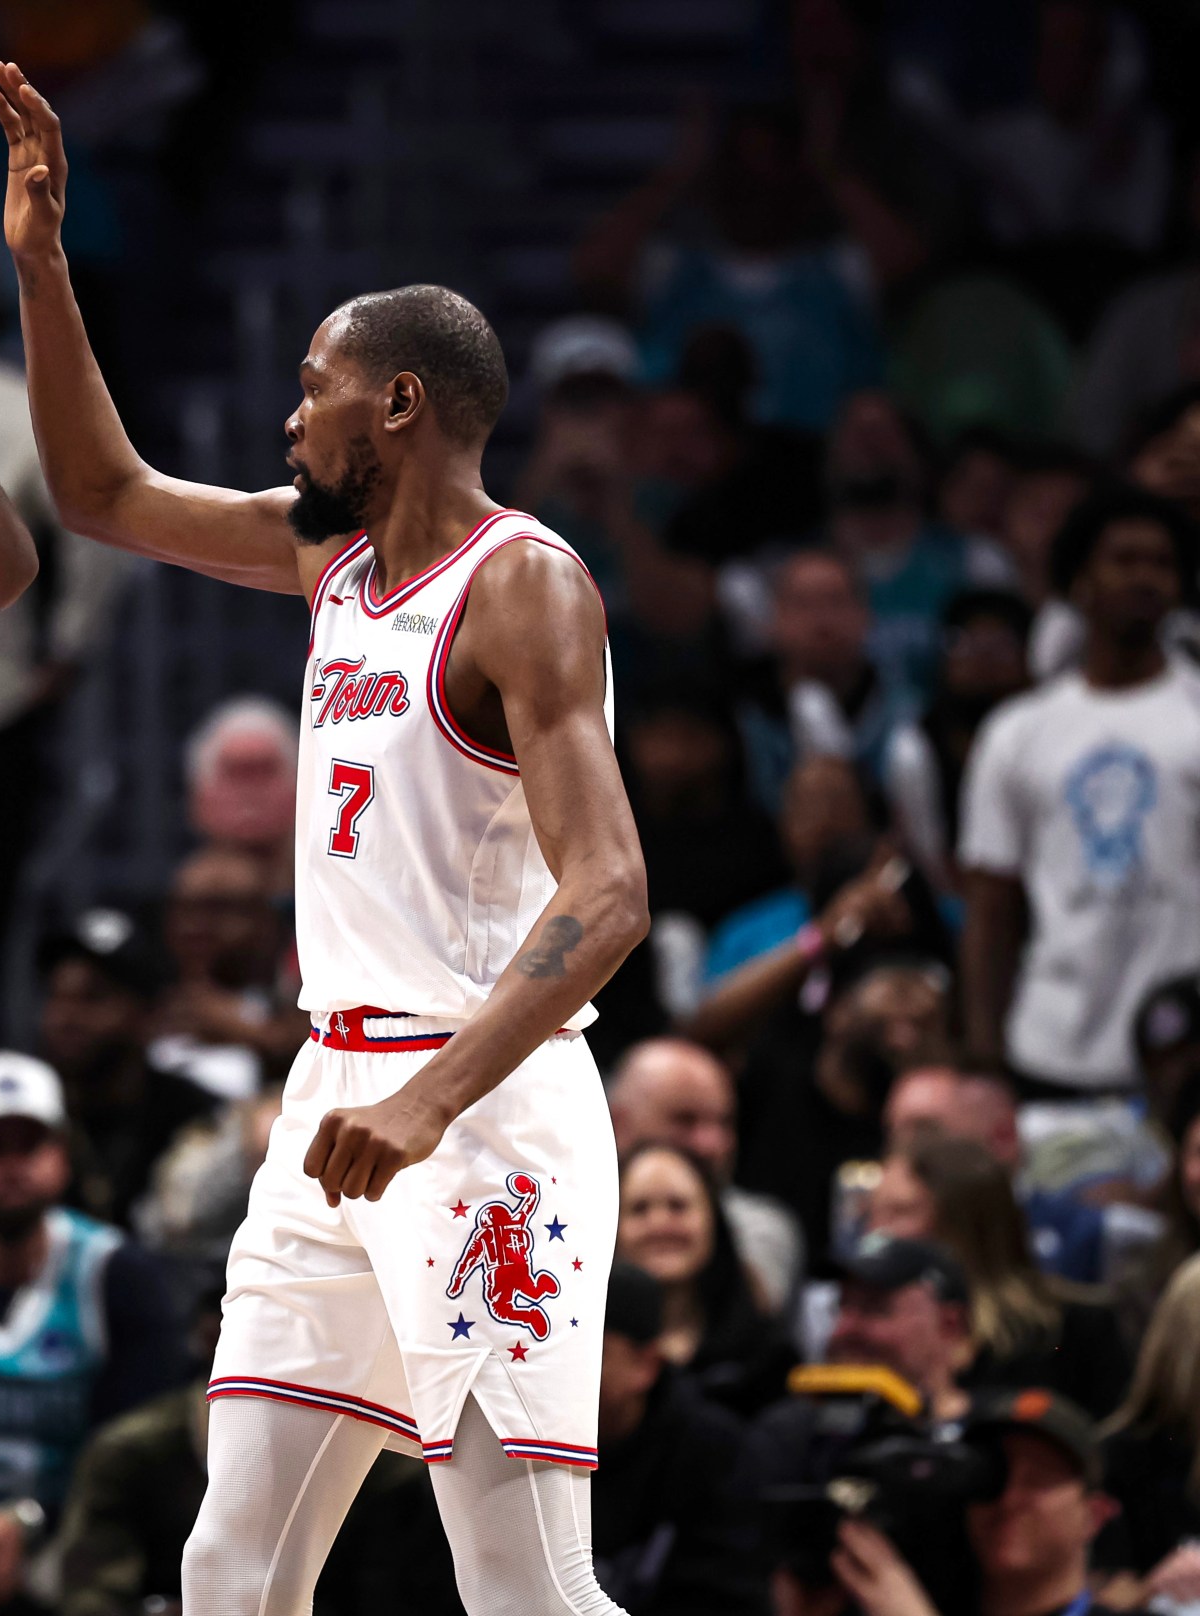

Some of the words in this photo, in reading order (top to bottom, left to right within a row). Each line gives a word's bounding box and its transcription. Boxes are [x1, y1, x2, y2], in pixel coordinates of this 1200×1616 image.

[391, 617, 436, 635] HERMANN
[395, 612, 439, 628] MEMORIAL
[311, 655, 410, 728] -Town
[327, 758, 375, 859] 7
